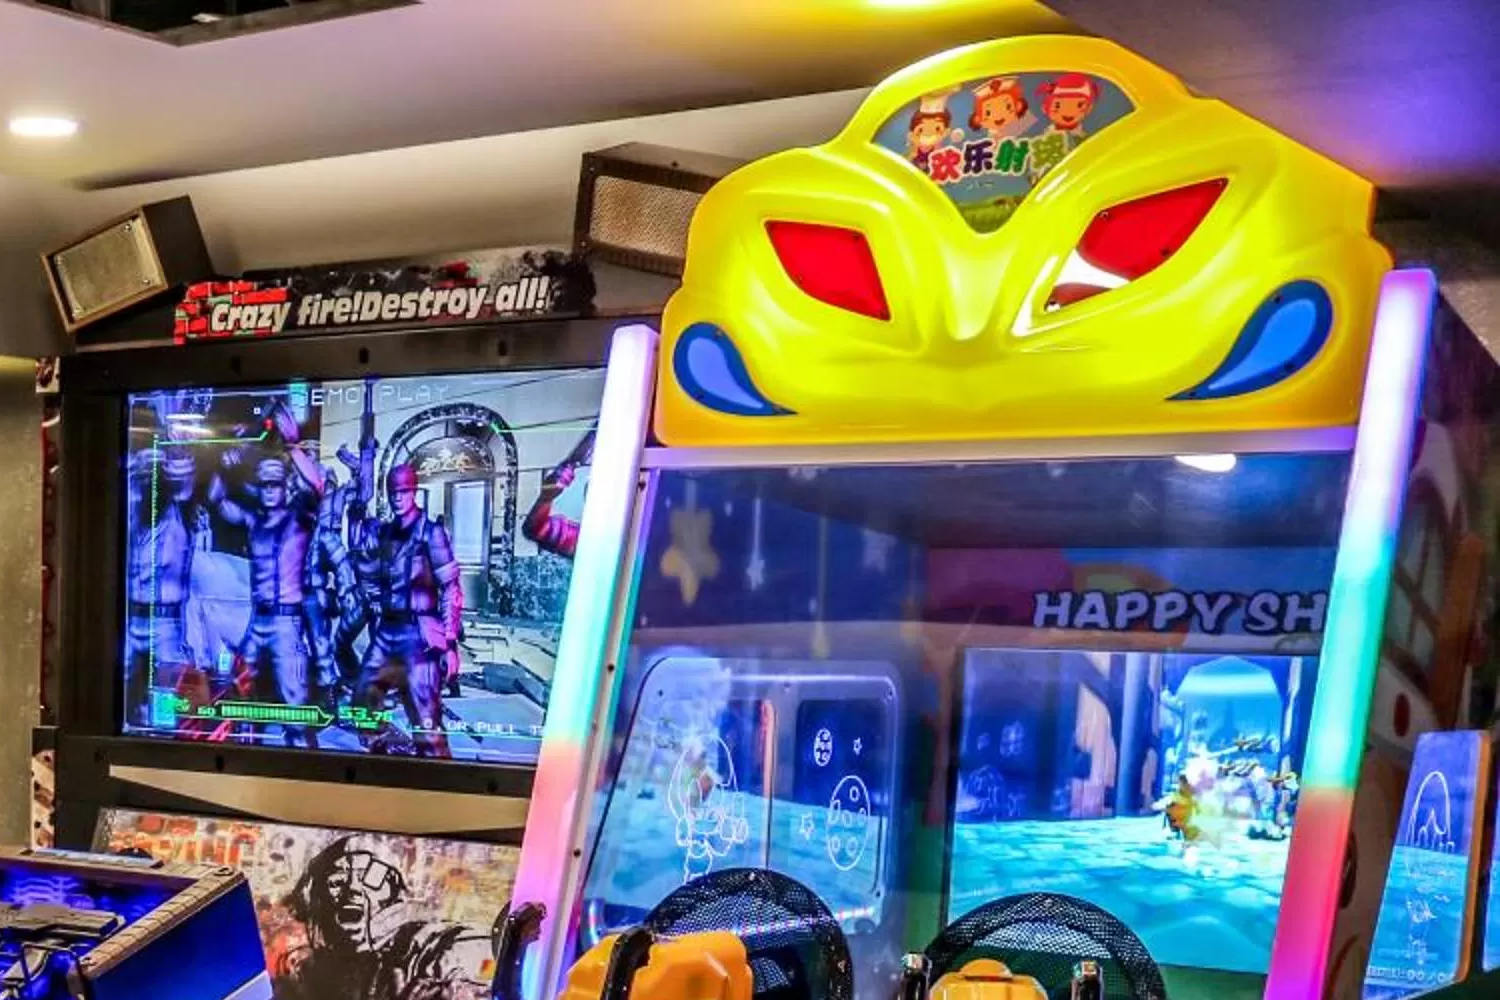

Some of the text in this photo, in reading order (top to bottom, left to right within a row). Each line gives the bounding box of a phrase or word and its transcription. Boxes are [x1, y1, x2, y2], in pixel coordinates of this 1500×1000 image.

[379, 384, 449, 404] PLAY
[1034, 591, 1327, 633] HAPPY SH
